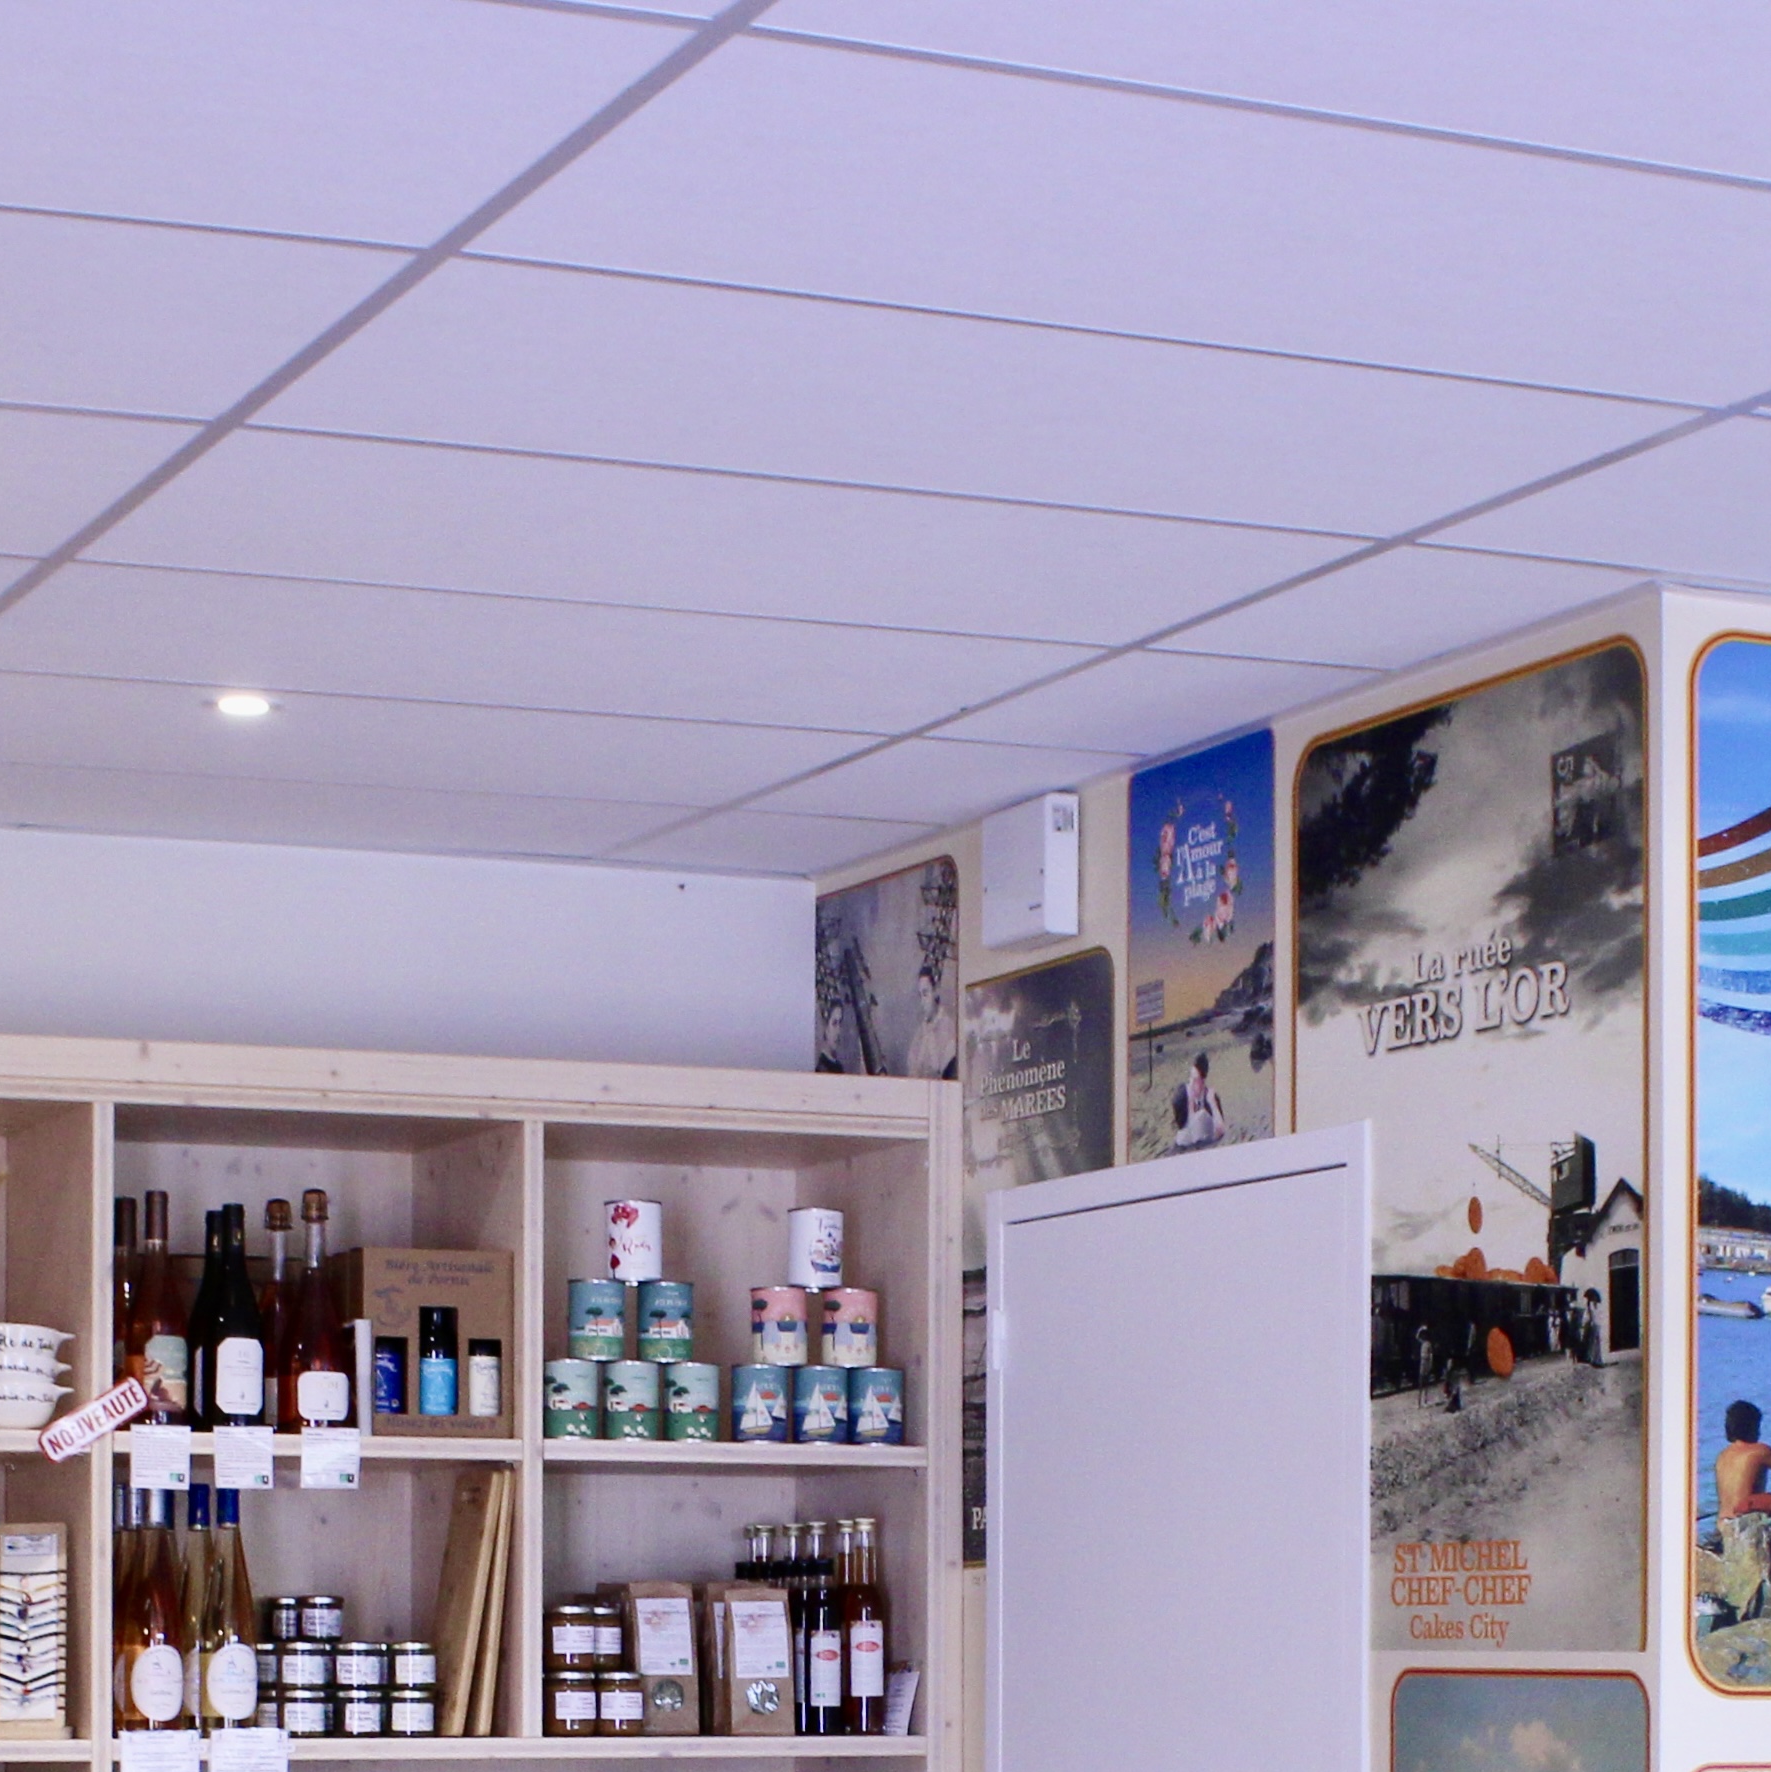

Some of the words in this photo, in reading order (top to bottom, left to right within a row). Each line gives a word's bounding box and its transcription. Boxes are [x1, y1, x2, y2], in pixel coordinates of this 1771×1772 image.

[1413, 950, 1445, 986] La
[1453, 929, 1513, 978] ruée
[1357, 989, 1463, 1056] VERS
[1476, 961, 1571, 1034] L'OR
[1013, 1039, 1031, 1061] Le
[979, 1058, 1066, 1097] Phénomène
[1393, 1542, 1424, 1573] ST
[1429, 1540, 1529, 1573] MICHEL
[1390, 1574, 1532, 1607] CHEF-CHEF
[1410, 1615, 1464, 1641] Cakes
[1469, 1612, 1509, 1648] City
